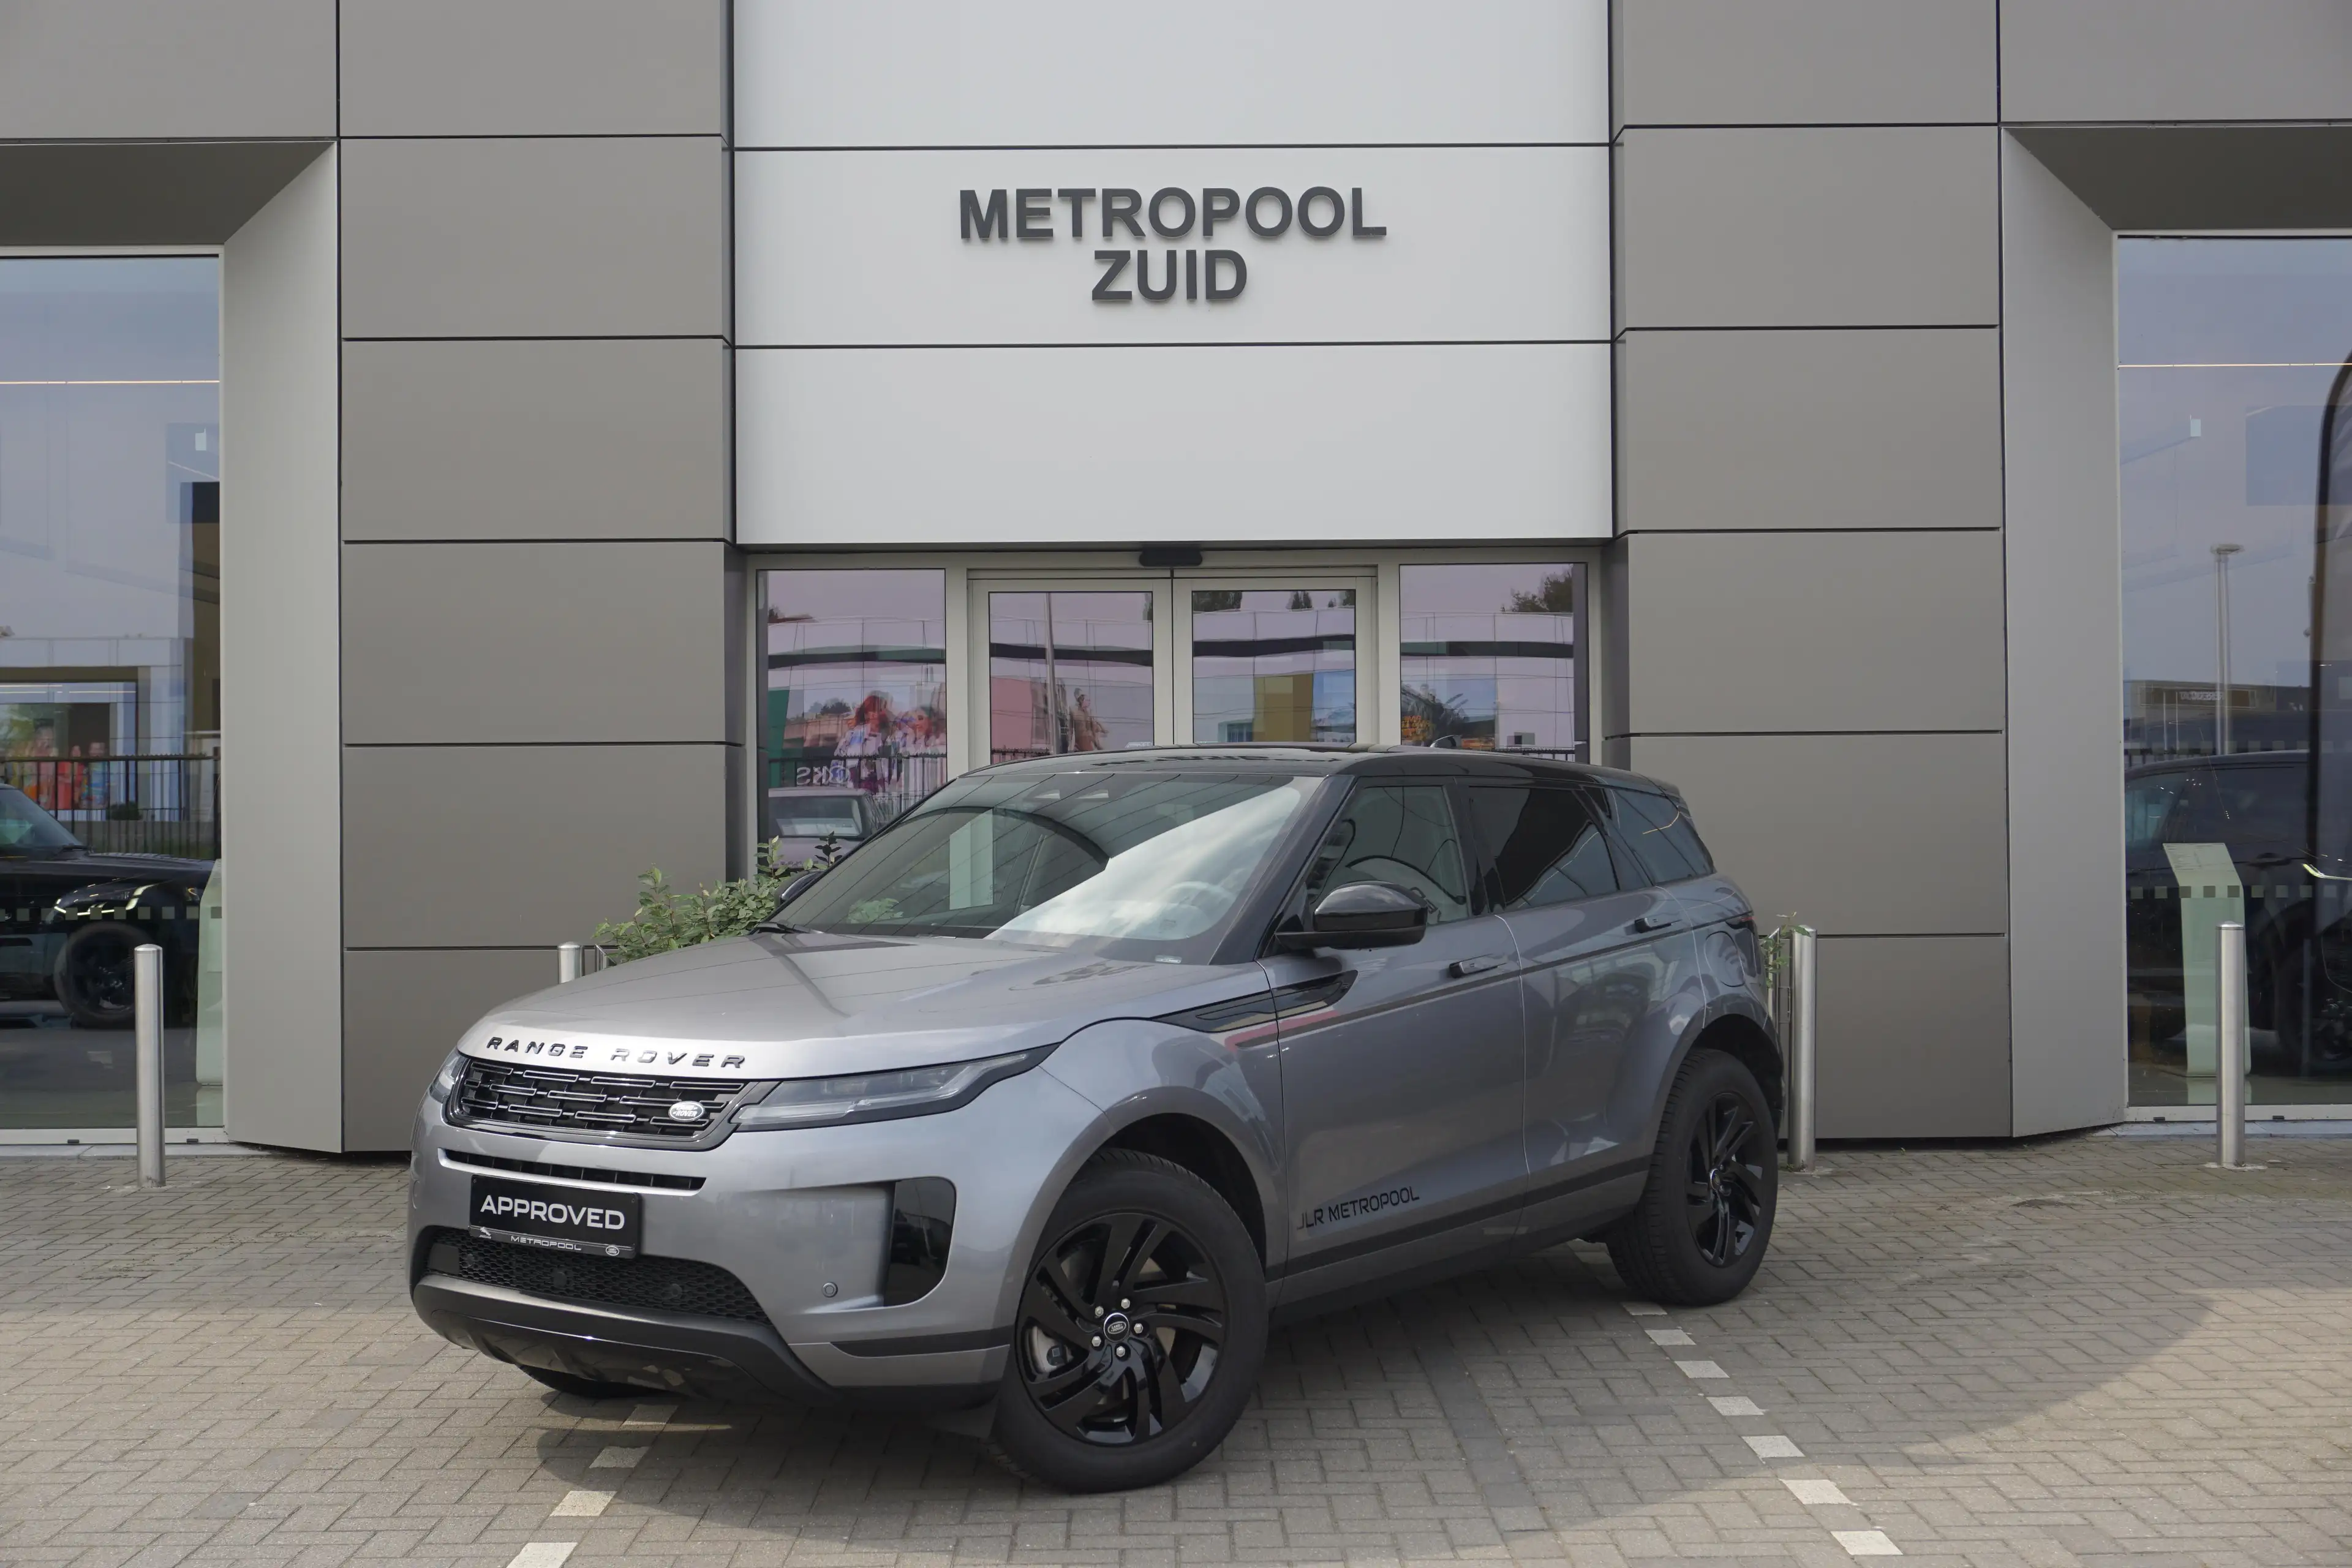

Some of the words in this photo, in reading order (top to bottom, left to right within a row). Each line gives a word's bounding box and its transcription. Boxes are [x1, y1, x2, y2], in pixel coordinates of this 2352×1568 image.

[960, 186, 1387, 239] METROPOOL
[1091, 249, 1247, 301] ZUID
[486, 1036, 588, 1058] RANGE
[610, 1048, 745, 1069] ROVER
[480, 1195, 625, 1230] APPROVED
[1297, 1208, 1324, 1230] JLR
[1329, 1186, 1420, 1222] METROPOOL
[511, 1235, 581, 1251] METROPOOL
